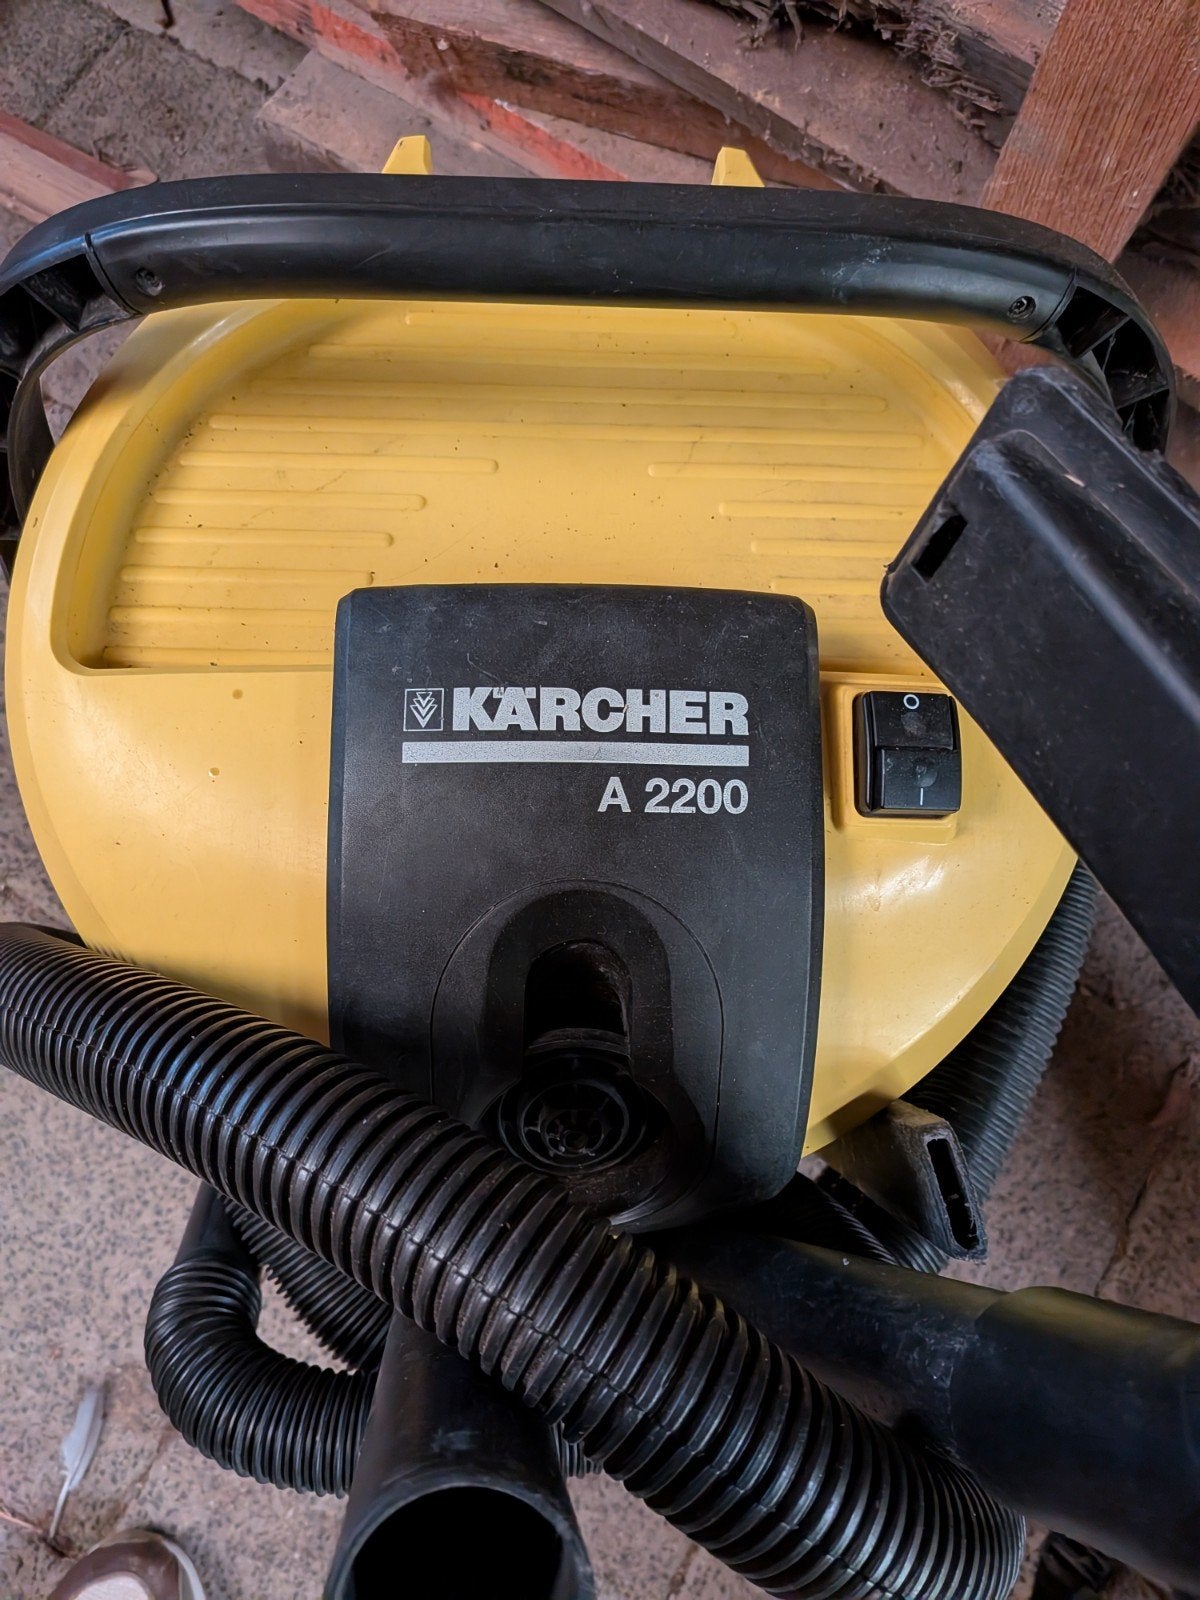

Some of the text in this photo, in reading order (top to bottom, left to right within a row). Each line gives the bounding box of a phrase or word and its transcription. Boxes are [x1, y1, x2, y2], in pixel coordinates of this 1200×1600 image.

[452, 685, 750, 736] KÄRCHER
[597, 776, 749, 815] A 2200
